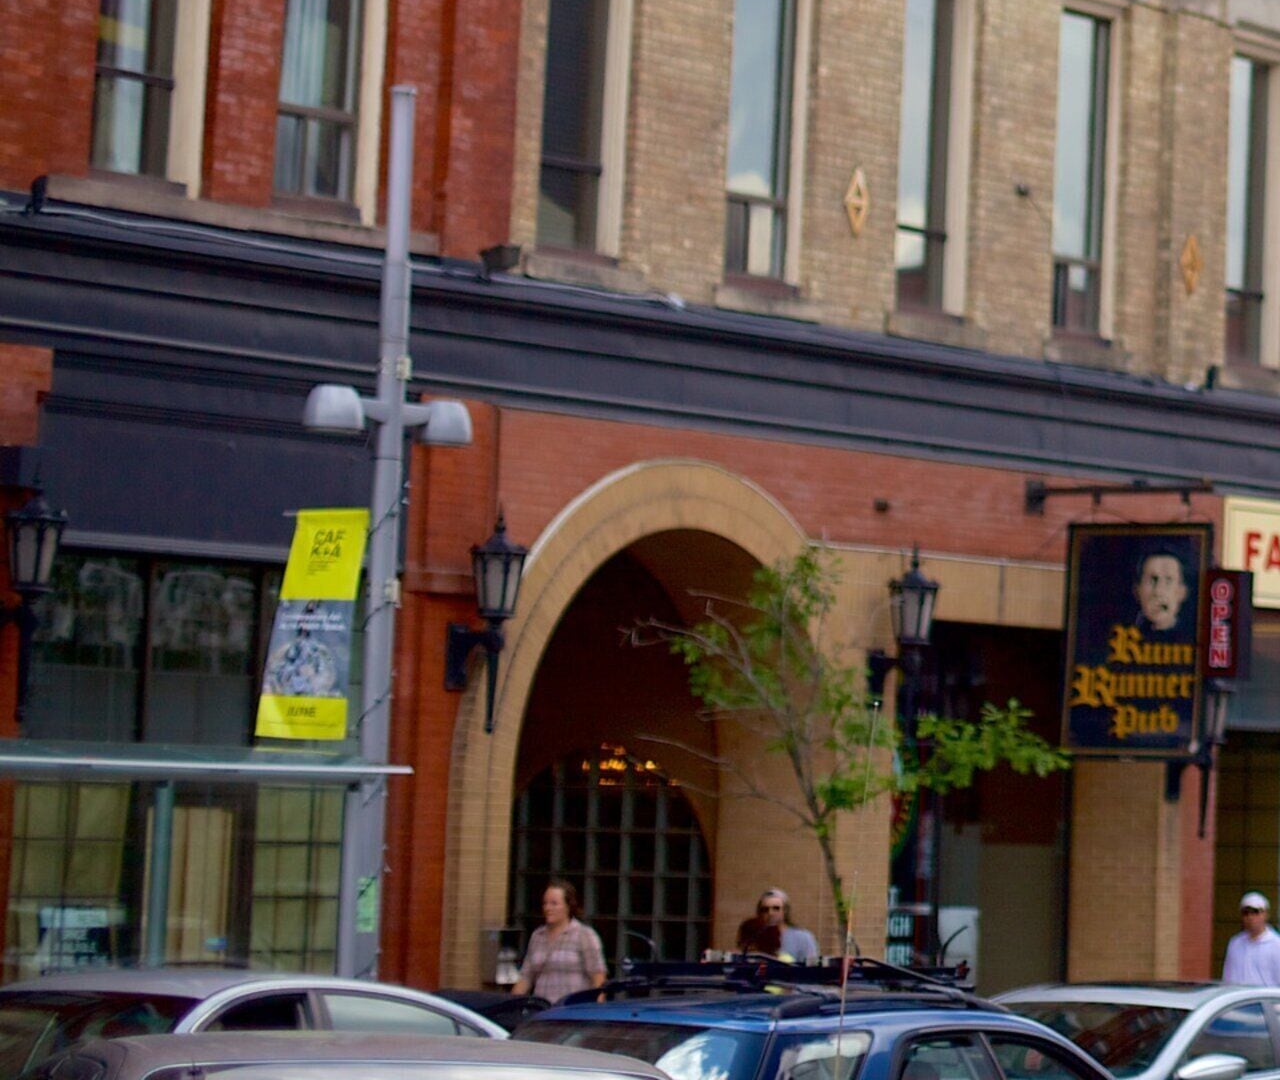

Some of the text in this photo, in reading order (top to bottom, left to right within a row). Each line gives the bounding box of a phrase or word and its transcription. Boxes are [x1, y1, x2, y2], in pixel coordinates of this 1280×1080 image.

[1107, 624, 1194, 665] Rum
[1209, 579, 1233, 668] OPEN
[1069, 665, 1195, 708] Runner
[1108, 703, 1180, 740] Pub
